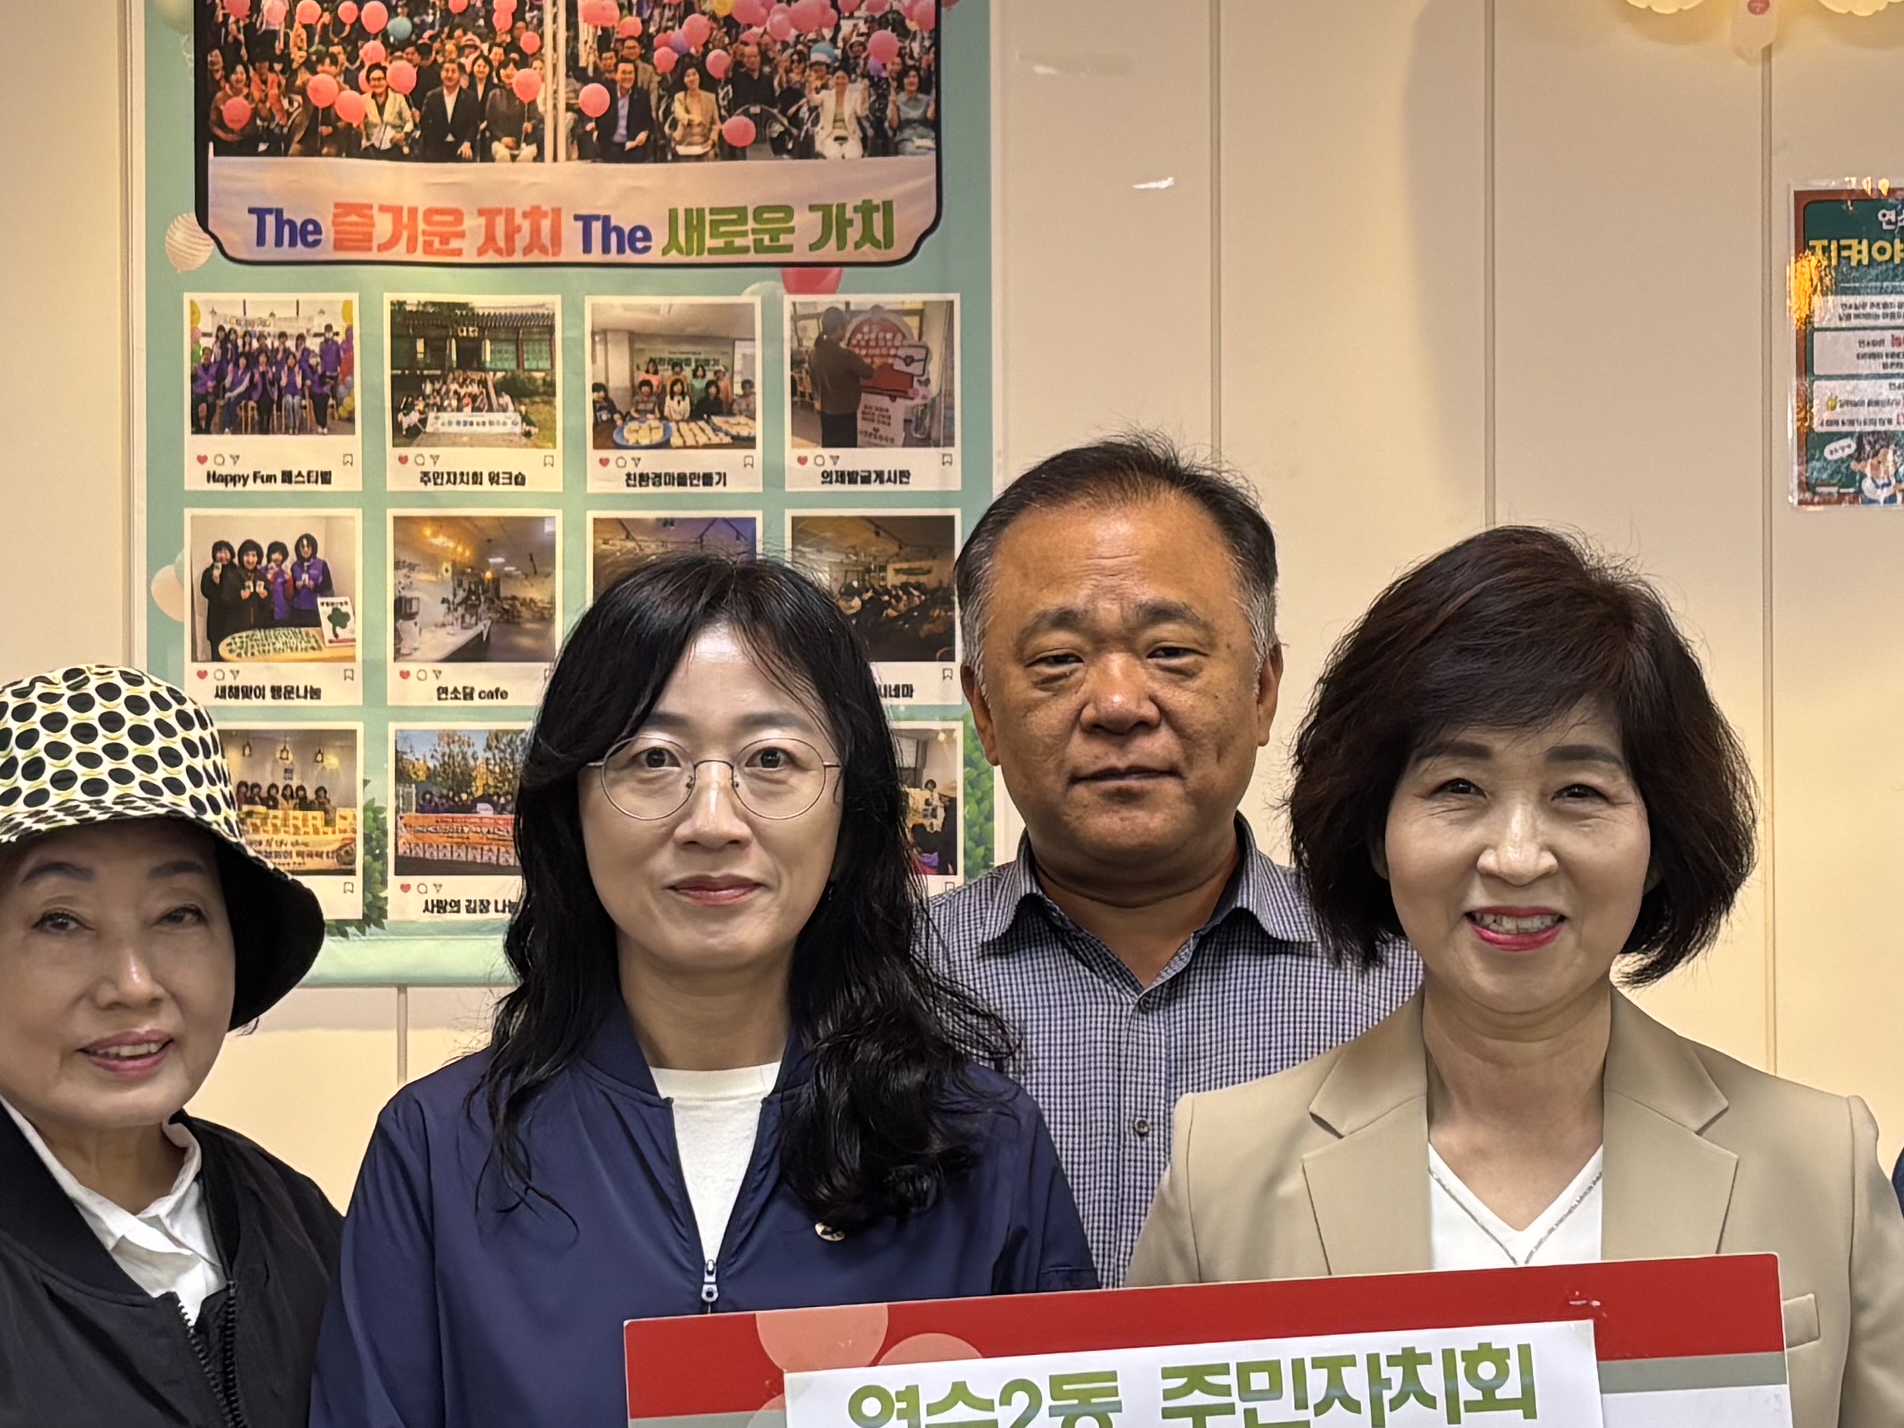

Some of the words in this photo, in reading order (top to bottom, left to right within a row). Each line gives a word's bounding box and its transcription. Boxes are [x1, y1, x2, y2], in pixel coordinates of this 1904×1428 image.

[248, 206, 323, 249] The
[332, 201, 466, 257] 즐거운
[476, 205, 562, 257] 자치
[573, 214, 653, 256] The
[661, 204, 795, 257] 새로운
[808, 199, 895, 253] 가치
[206, 470, 250, 488] Happy
[252, 470, 278, 484] Fun
[419, 470, 484, 486] 주민자치회
[625, 471, 727, 488] 친환경마을만들기
